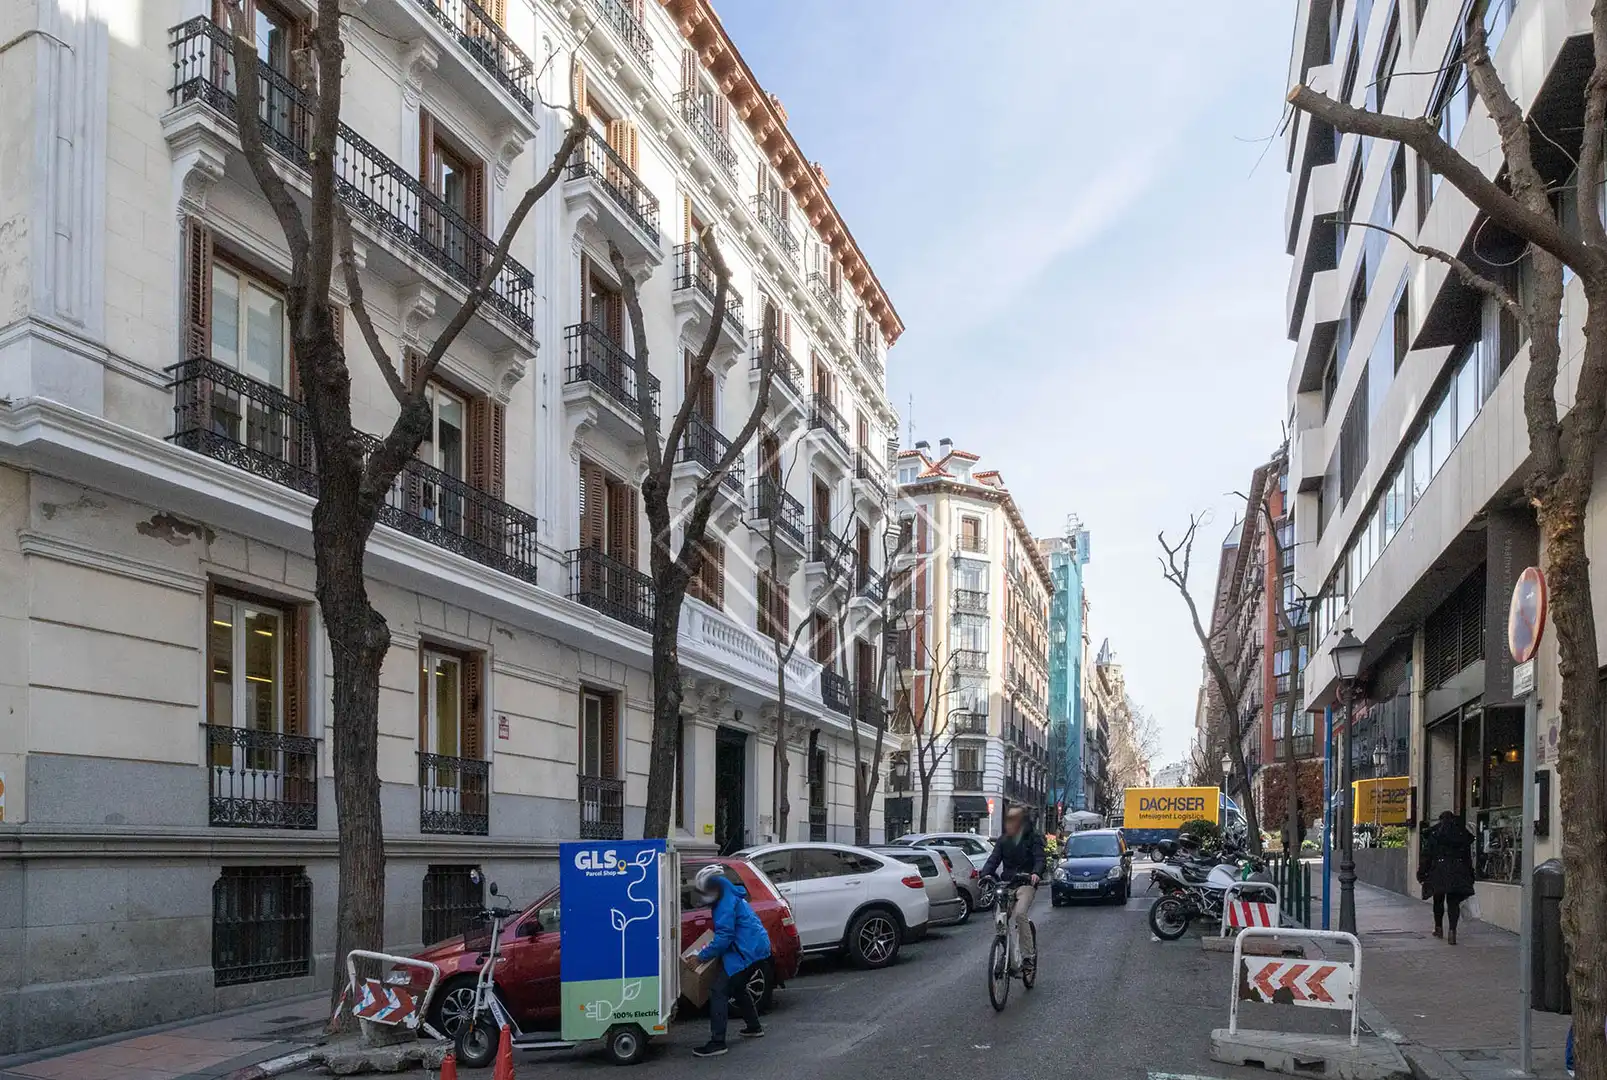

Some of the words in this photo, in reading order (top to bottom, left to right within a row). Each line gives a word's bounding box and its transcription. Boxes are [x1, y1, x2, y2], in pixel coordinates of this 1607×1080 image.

[1140, 797, 1205, 811] DACHSER
[574, 849, 617, 870] GLS
[613, 1011, 633, 1019] 100%
[634, 1009, 660, 1018] Electric
